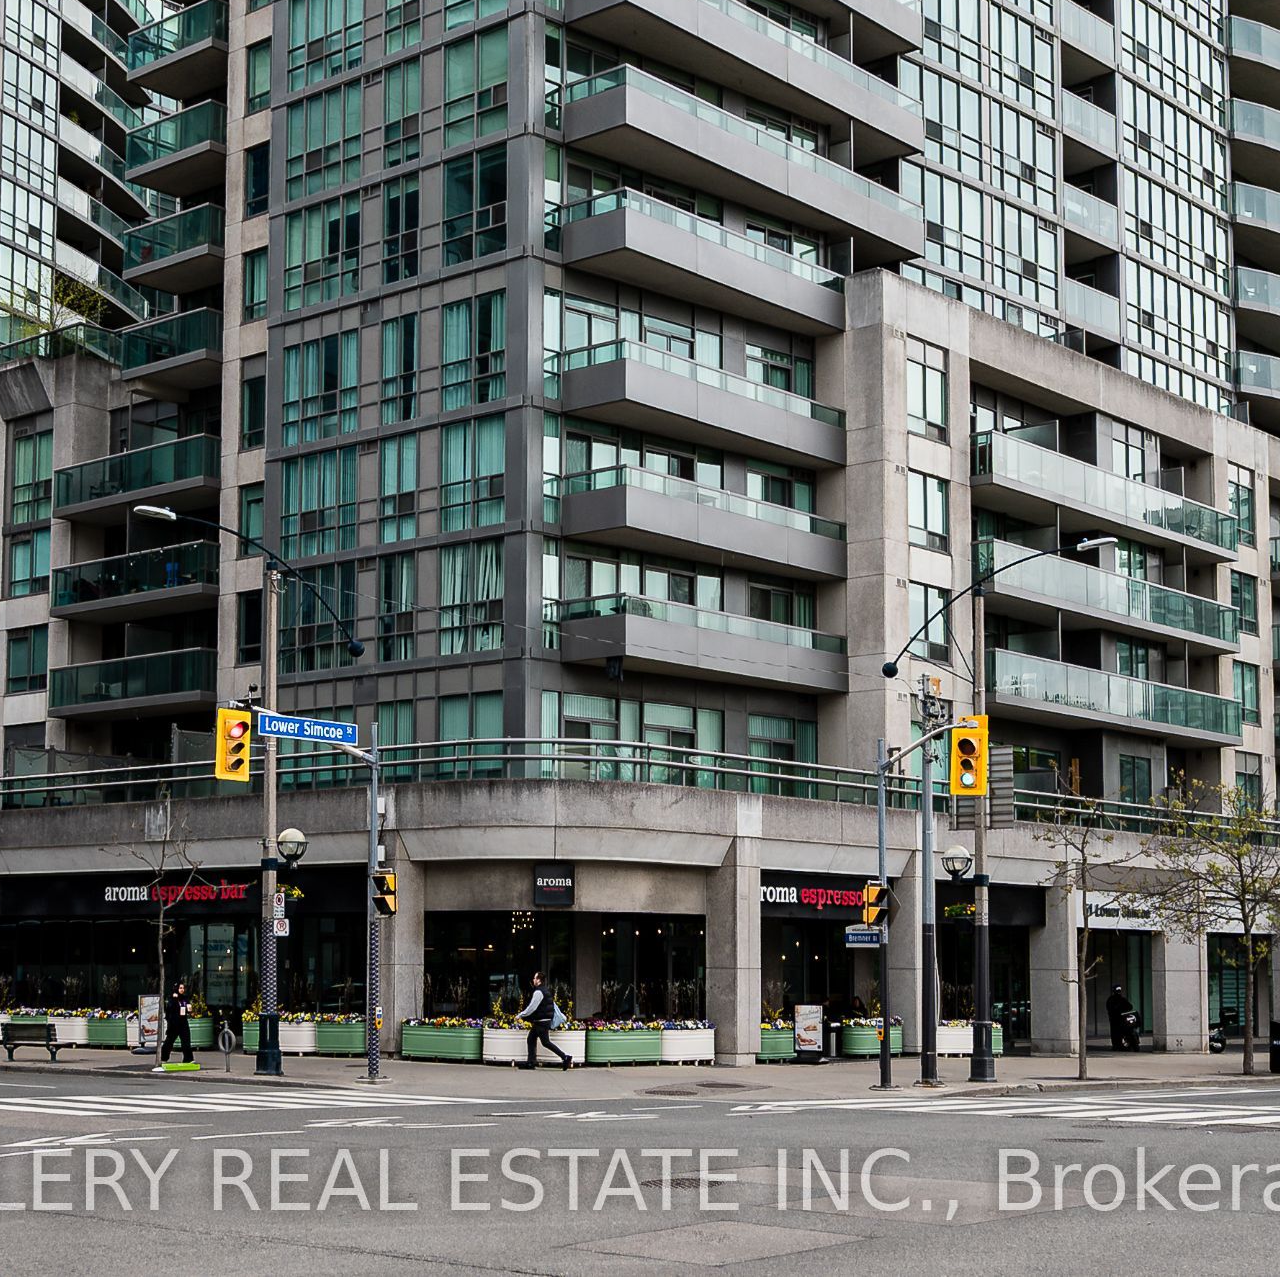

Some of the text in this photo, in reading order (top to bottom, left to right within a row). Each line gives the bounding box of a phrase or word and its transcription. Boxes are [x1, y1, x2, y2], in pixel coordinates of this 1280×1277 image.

[265, 717, 299, 734] Lower
[304, 722, 343, 739] Simcoe
[105, 878, 248, 907] aroma espresso bar
[537, 878, 572, 887] aroma
[760, 885, 864, 910] roma espresso
